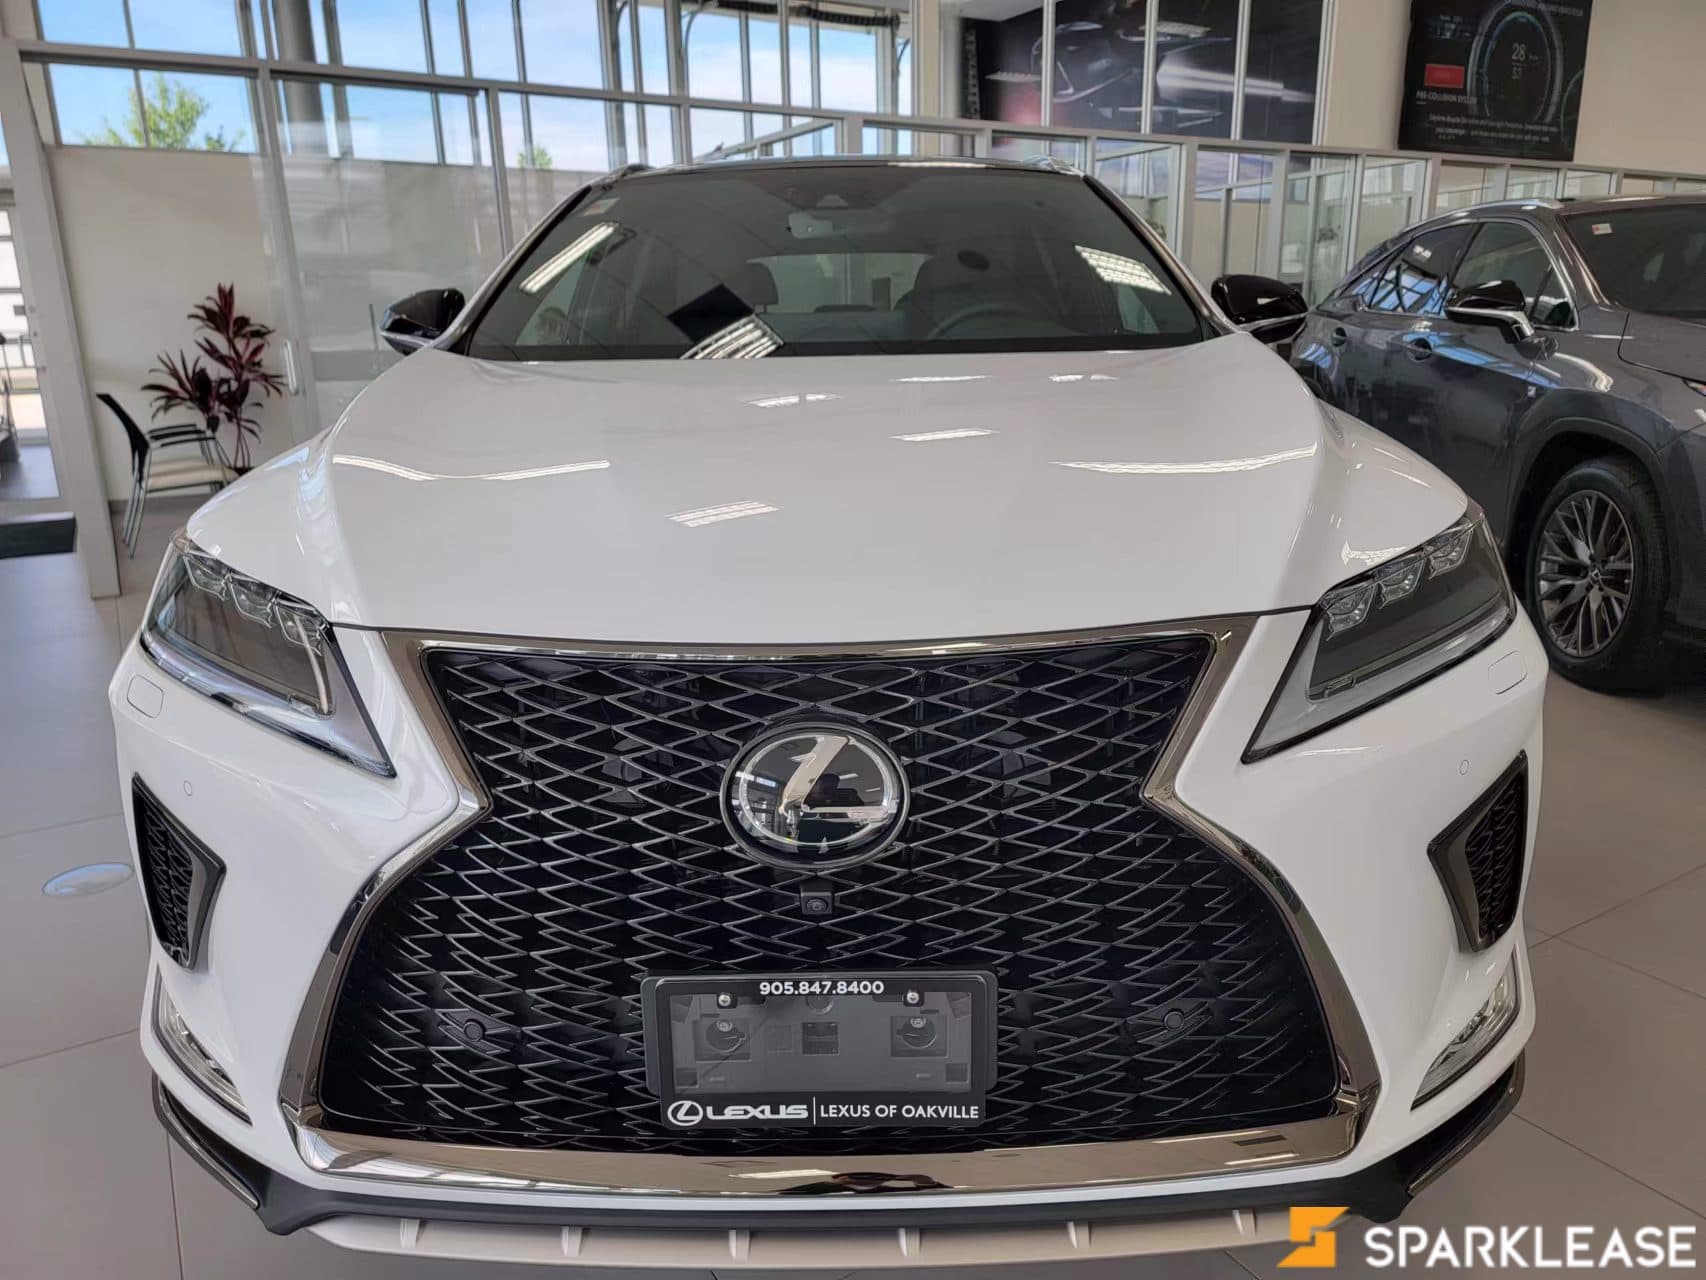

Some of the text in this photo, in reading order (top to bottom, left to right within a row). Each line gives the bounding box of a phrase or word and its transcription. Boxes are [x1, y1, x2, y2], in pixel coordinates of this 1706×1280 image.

[759, 980, 885, 995] 905.847.8400
[706, 1104, 809, 1121] LEXUS
[820, 1104, 871, 1119] LEXUS
[874, 1104, 897, 1119] OF
[901, 1105, 979, 1119] OAKVILLE
